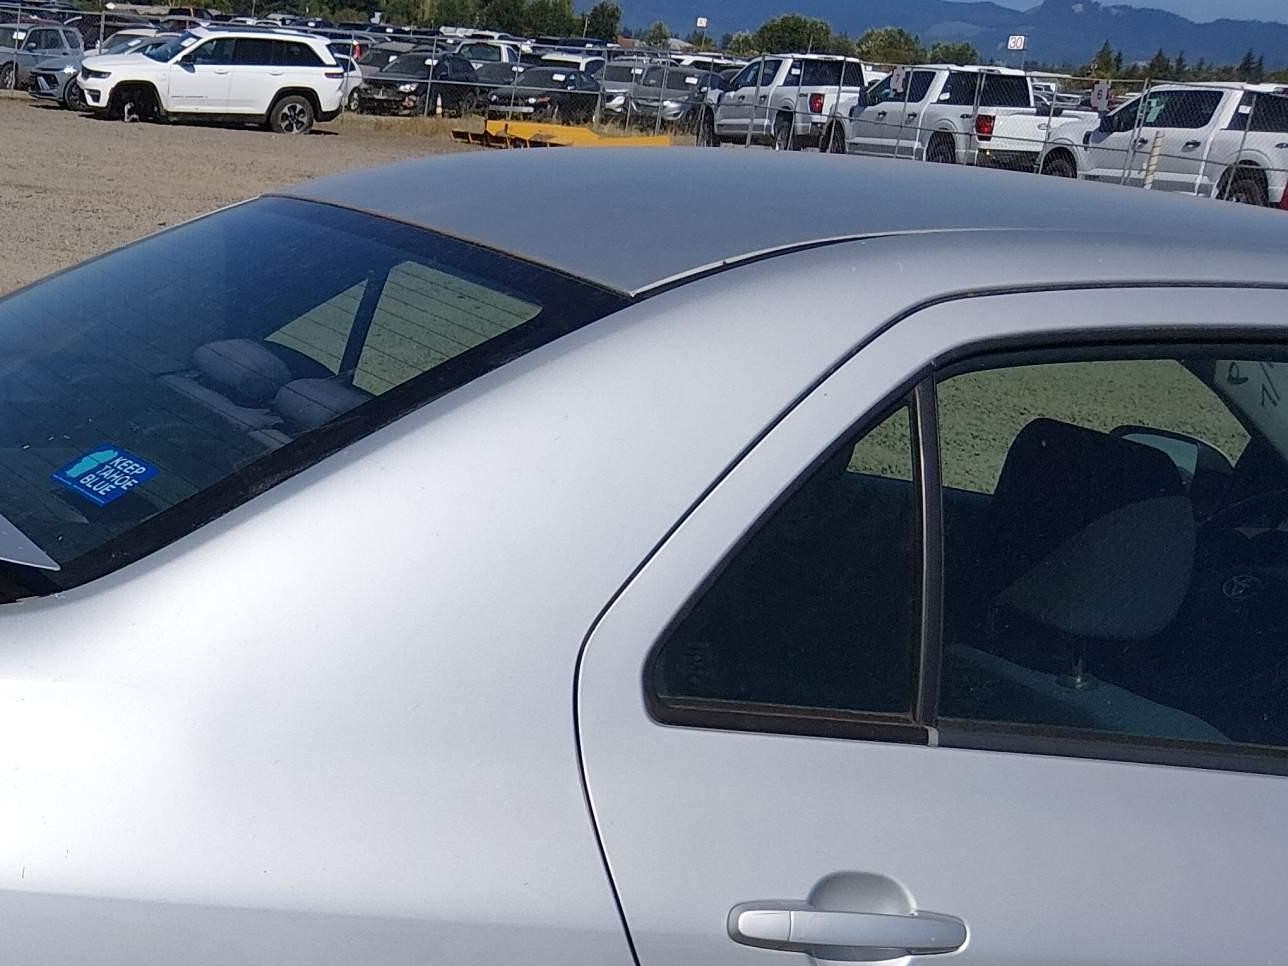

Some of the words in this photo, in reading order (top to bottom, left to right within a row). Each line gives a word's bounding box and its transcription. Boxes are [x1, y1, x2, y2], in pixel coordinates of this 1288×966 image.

[1009, 36, 1023, 49] 30
[110, 456, 146, 476] KEEP
[79, 473, 117, 496] BLUE
[95, 464, 139, 491] TAHOE
